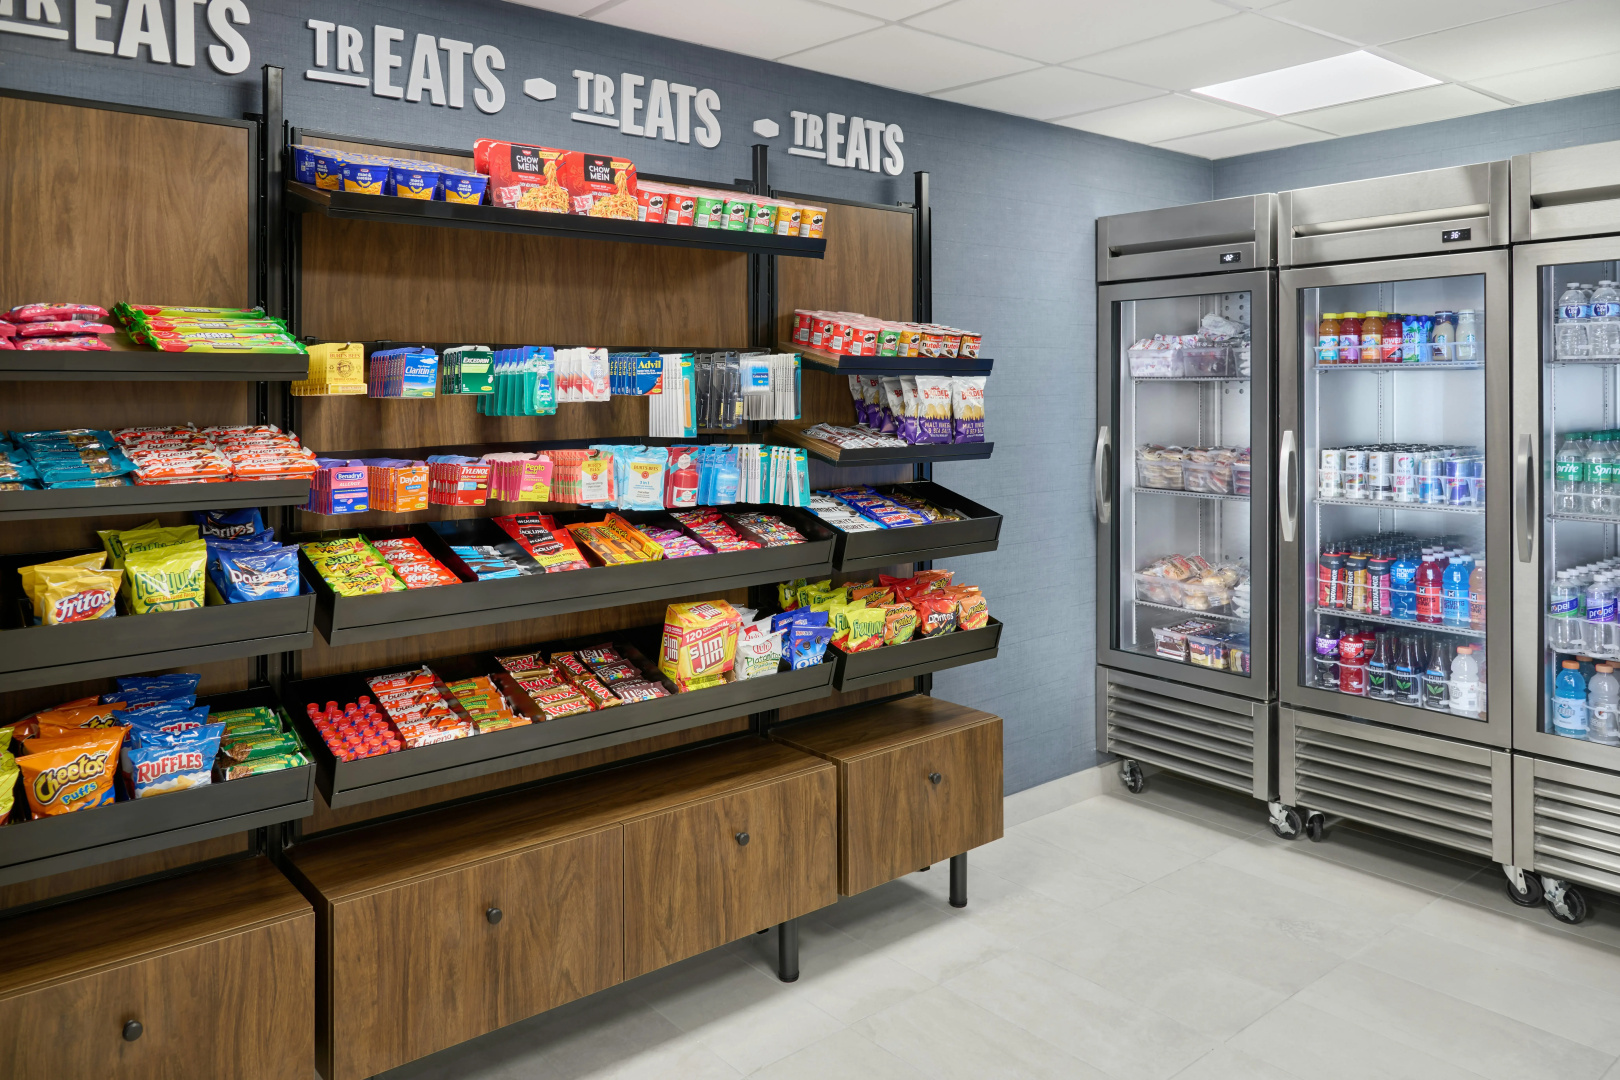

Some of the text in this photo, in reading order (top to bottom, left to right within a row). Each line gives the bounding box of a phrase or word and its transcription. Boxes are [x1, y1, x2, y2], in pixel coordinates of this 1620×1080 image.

[0, 0, 904, 176] EATS TREATS TREATS TREATS
[516, 155, 539, 164] CHOW
[517, 162, 539, 172] MEIN
[588, 165, 610, 174] CHOW
[590, 172, 610, 182] MEIN
[405, 366, 430, 374] Claritin
[638, 360, 662, 368] Advil
[148, 442, 182, 450] bueno
[462, 466, 488, 475] TYLENOL
[526, 463, 545, 472] Pepto
[338, 472, 363, 480] Benadryl
[400, 474, 426, 485] DayQuil
[882, 514, 910, 523] CRUNCH
[202, 522, 254, 536] Doritos
[608, 518, 628, 538] Reese's
[326, 554, 360, 565] SOUR
[230, 568, 288, 584] Doritos
[55, 590, 111, 622] Fritos
[690, 604, 714, 615] slim
[1589, 605, 1614, 618] propel
[704, 608, 722, 620] jim
[928, 612, 954, 624] Doritos
[664, 634, 678, 649] slim
[686, 630, 702, 643] 120
[665, 647, 678, 660] jim
[690, 636, 723, 660] slim
[559, 654, 586, 674] TWIX
[696, 648, 724, 673] jim
[382, 672, 408, 680] bueno
[519, 678, 556, 692] TWIX
[583, 678, 613, 699] TWIX
[388, 690, 415, 700] bueno
[537, 690, 577, 703] TWIX
[542, 701, 584, 716] TWIX
[137, 752, 202, 783] RUFFLES
[34, 752, 108, 805] Cheetos
[61, 781, 98, 804] Puffs
